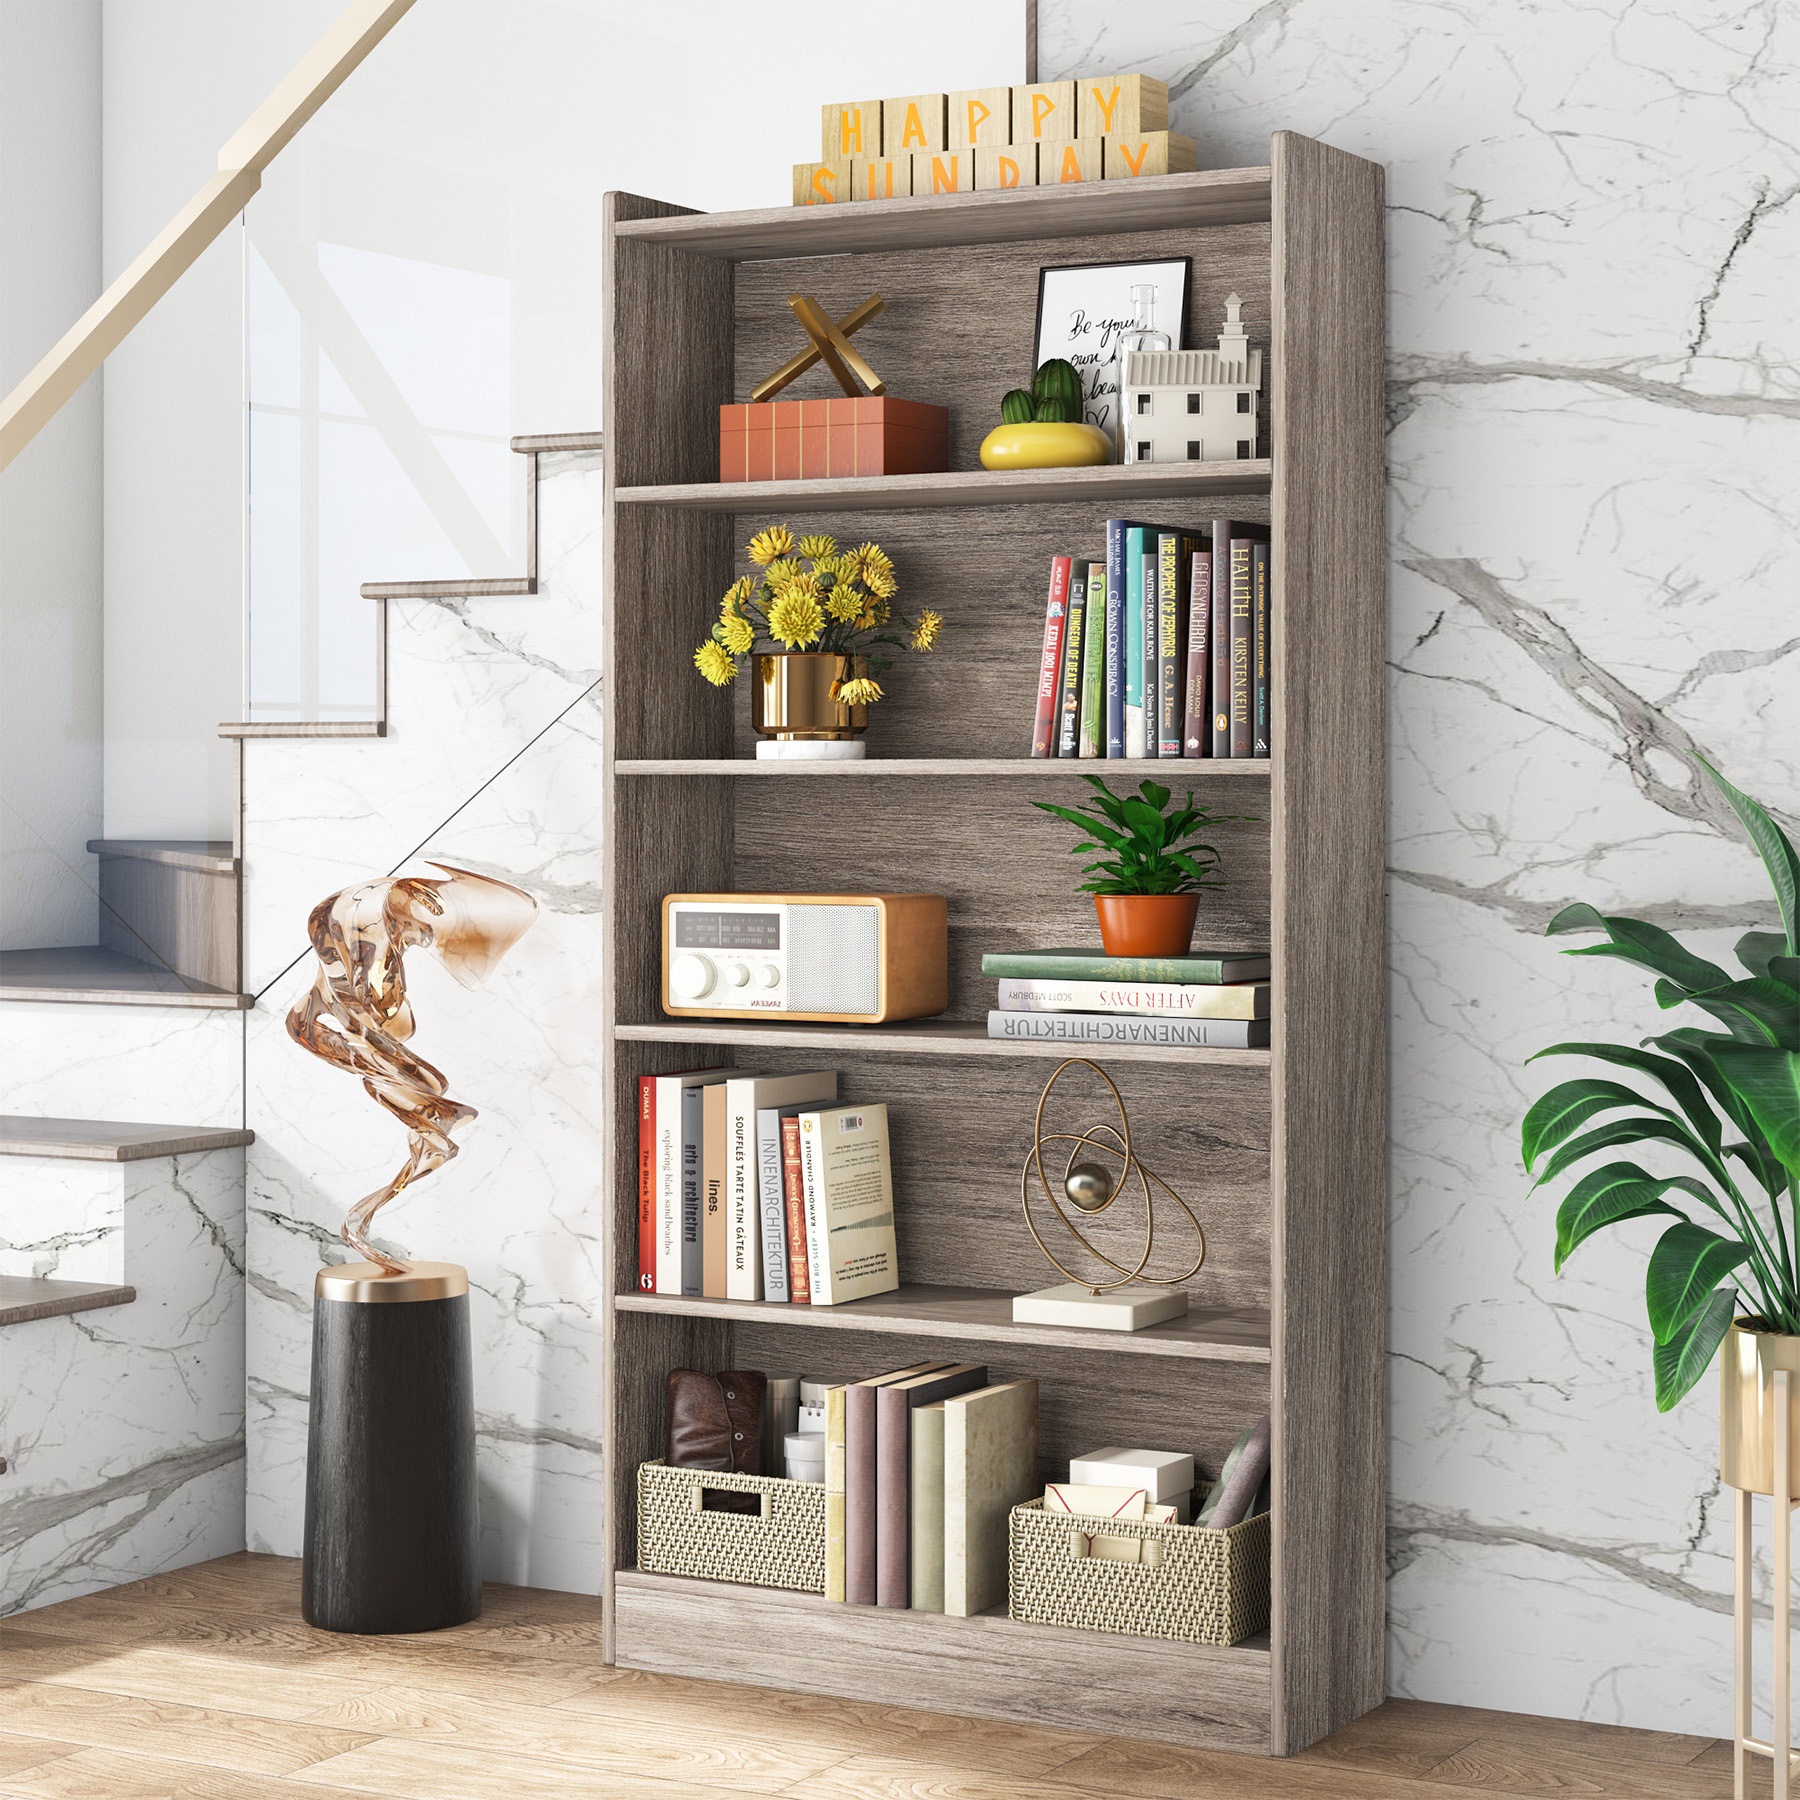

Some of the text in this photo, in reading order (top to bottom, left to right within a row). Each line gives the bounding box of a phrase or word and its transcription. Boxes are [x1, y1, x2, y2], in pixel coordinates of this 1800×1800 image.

[841, 86, 1121, 154] HAPPY
[807, 143, 1149, 205] SUNDAY
[1068, 310, 1092, 341] Be
[1217, 546, 1226, 554] A
[1217, 555, 1226, 581] Good
[1258, 562, 1265, 571] ON
[1161, 538, 1176, 657] THE PROPHECY OF ZEPHYRUS
[1190, 562, 1209, 653] GEOSYNCHRON
[1217, 582, 1226, 603] Man
[1068, 608, 1081, 646] DUNGEON
[1146, 569, 1155, 660] WAITING FOR KARL ROVE
[1217, 613, 1226, 636] Hard
[1108, 590, 1119, 697] CROWN CONSPIRACY
[1258, 632, 1265, 641] OF
[1041, 625, 1059, 697] KEDAI 1001 MIMPI
[1068, 648, 1079, 660] OF
[1217, 648, 1226, 667] Find
[1066, 661, 1077, 688] DEATH
[1146, 683, 1155, 694] Kat
[1194, 675, 1202, 695] DAVID
[1234, 637, 1247, 724] KIRSTEN KELLY
[1146, 695, 1155, 711] Nove
[1163, 665, 1174, 729] G. A. Hesse
[1187, 679, 1195, 714] EDELMAN
[1062, 713, 1075, 751] Scott Keith
[1146, 730, 1155, 750] Decker
[1008, 991, 1072, 1002] SCOTT MEDBURY
[1099, 990, 1196, 1009] AFTER DAYS
[1004, 1018, 1208, 1044] INNENARCHITEKTUR
[735, 1116, 747, 1161] SOUFFLÉS
[684, 1144, 700, 1164] arts
[662, 1129, 673, 1256] exploring black sand beaches
[735, 1164, 744, 1194] TARTE
[804, 1140, 816, 1227] RAYMOND CHANDLER
[642, 1198, 650, 1222] Tulip
[684, 1181, 700, 1242] architecture
[708, 1179, 720, 1216] lines.
[735, 1196, 744, 1223] TATIN
[762, 1138, 784, 1290] INNENARCHITEKTUR
